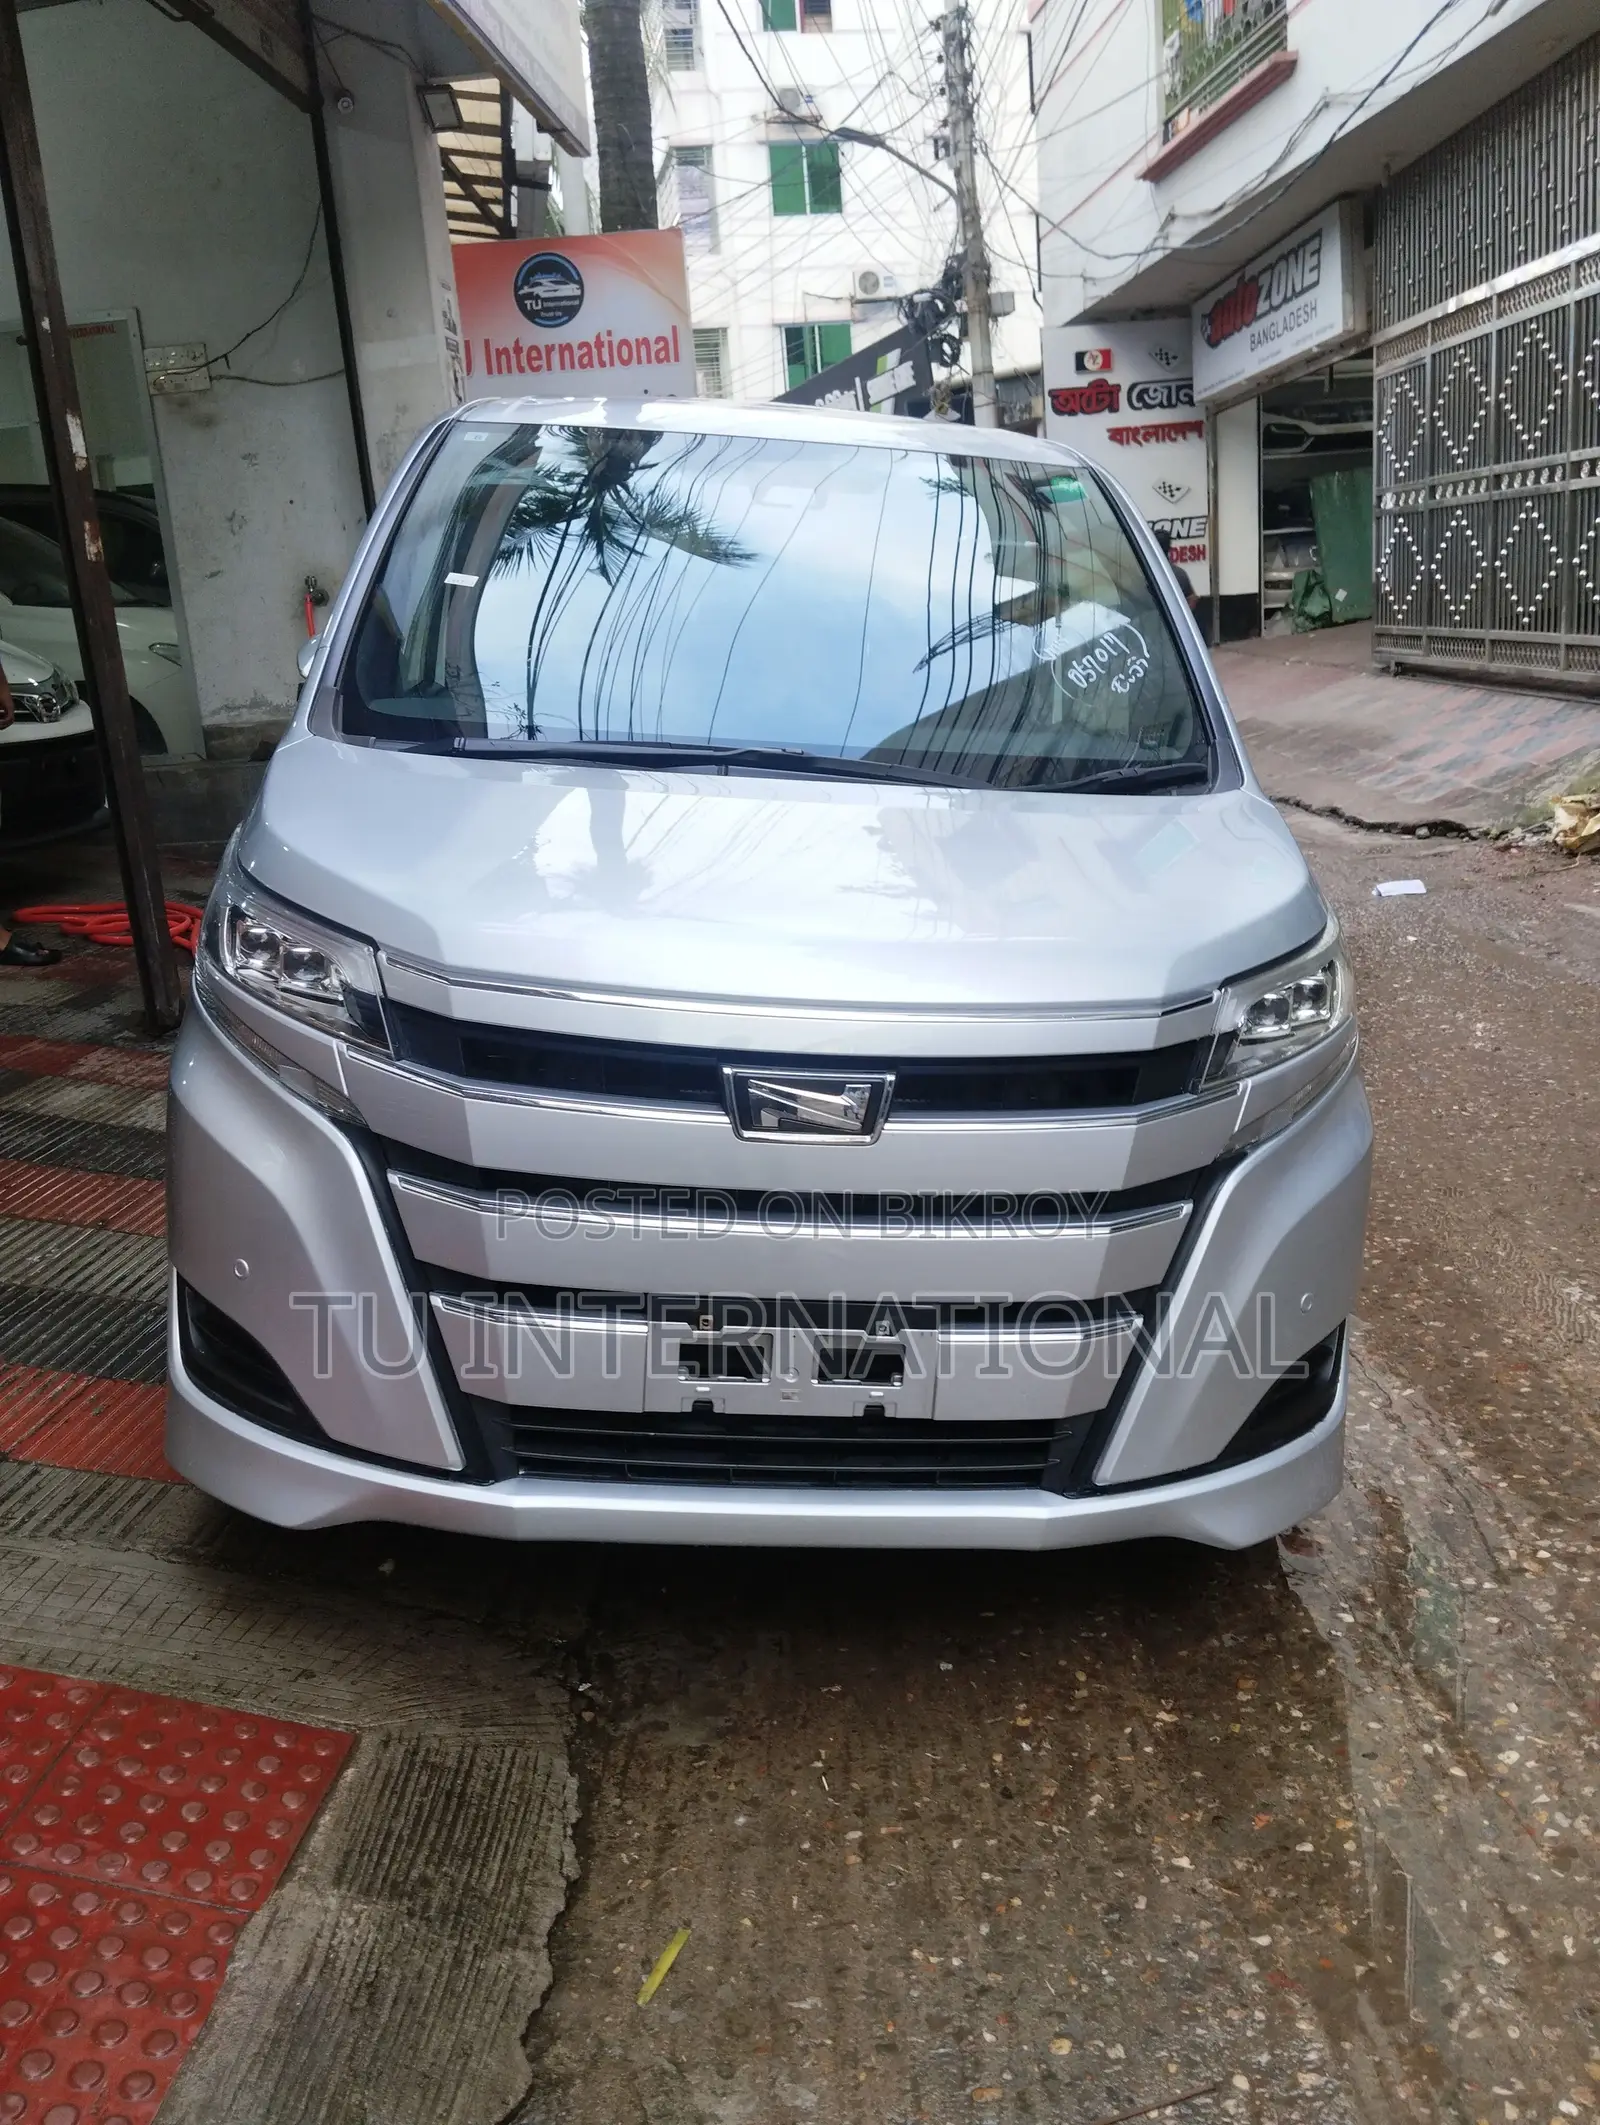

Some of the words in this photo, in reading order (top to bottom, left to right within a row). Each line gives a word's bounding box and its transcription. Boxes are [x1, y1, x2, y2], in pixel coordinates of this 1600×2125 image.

[524, 299, 541, 310] TU
[1250, 298, 1318, 351] BANGLADESH
[483, 325, 680, 376] International
